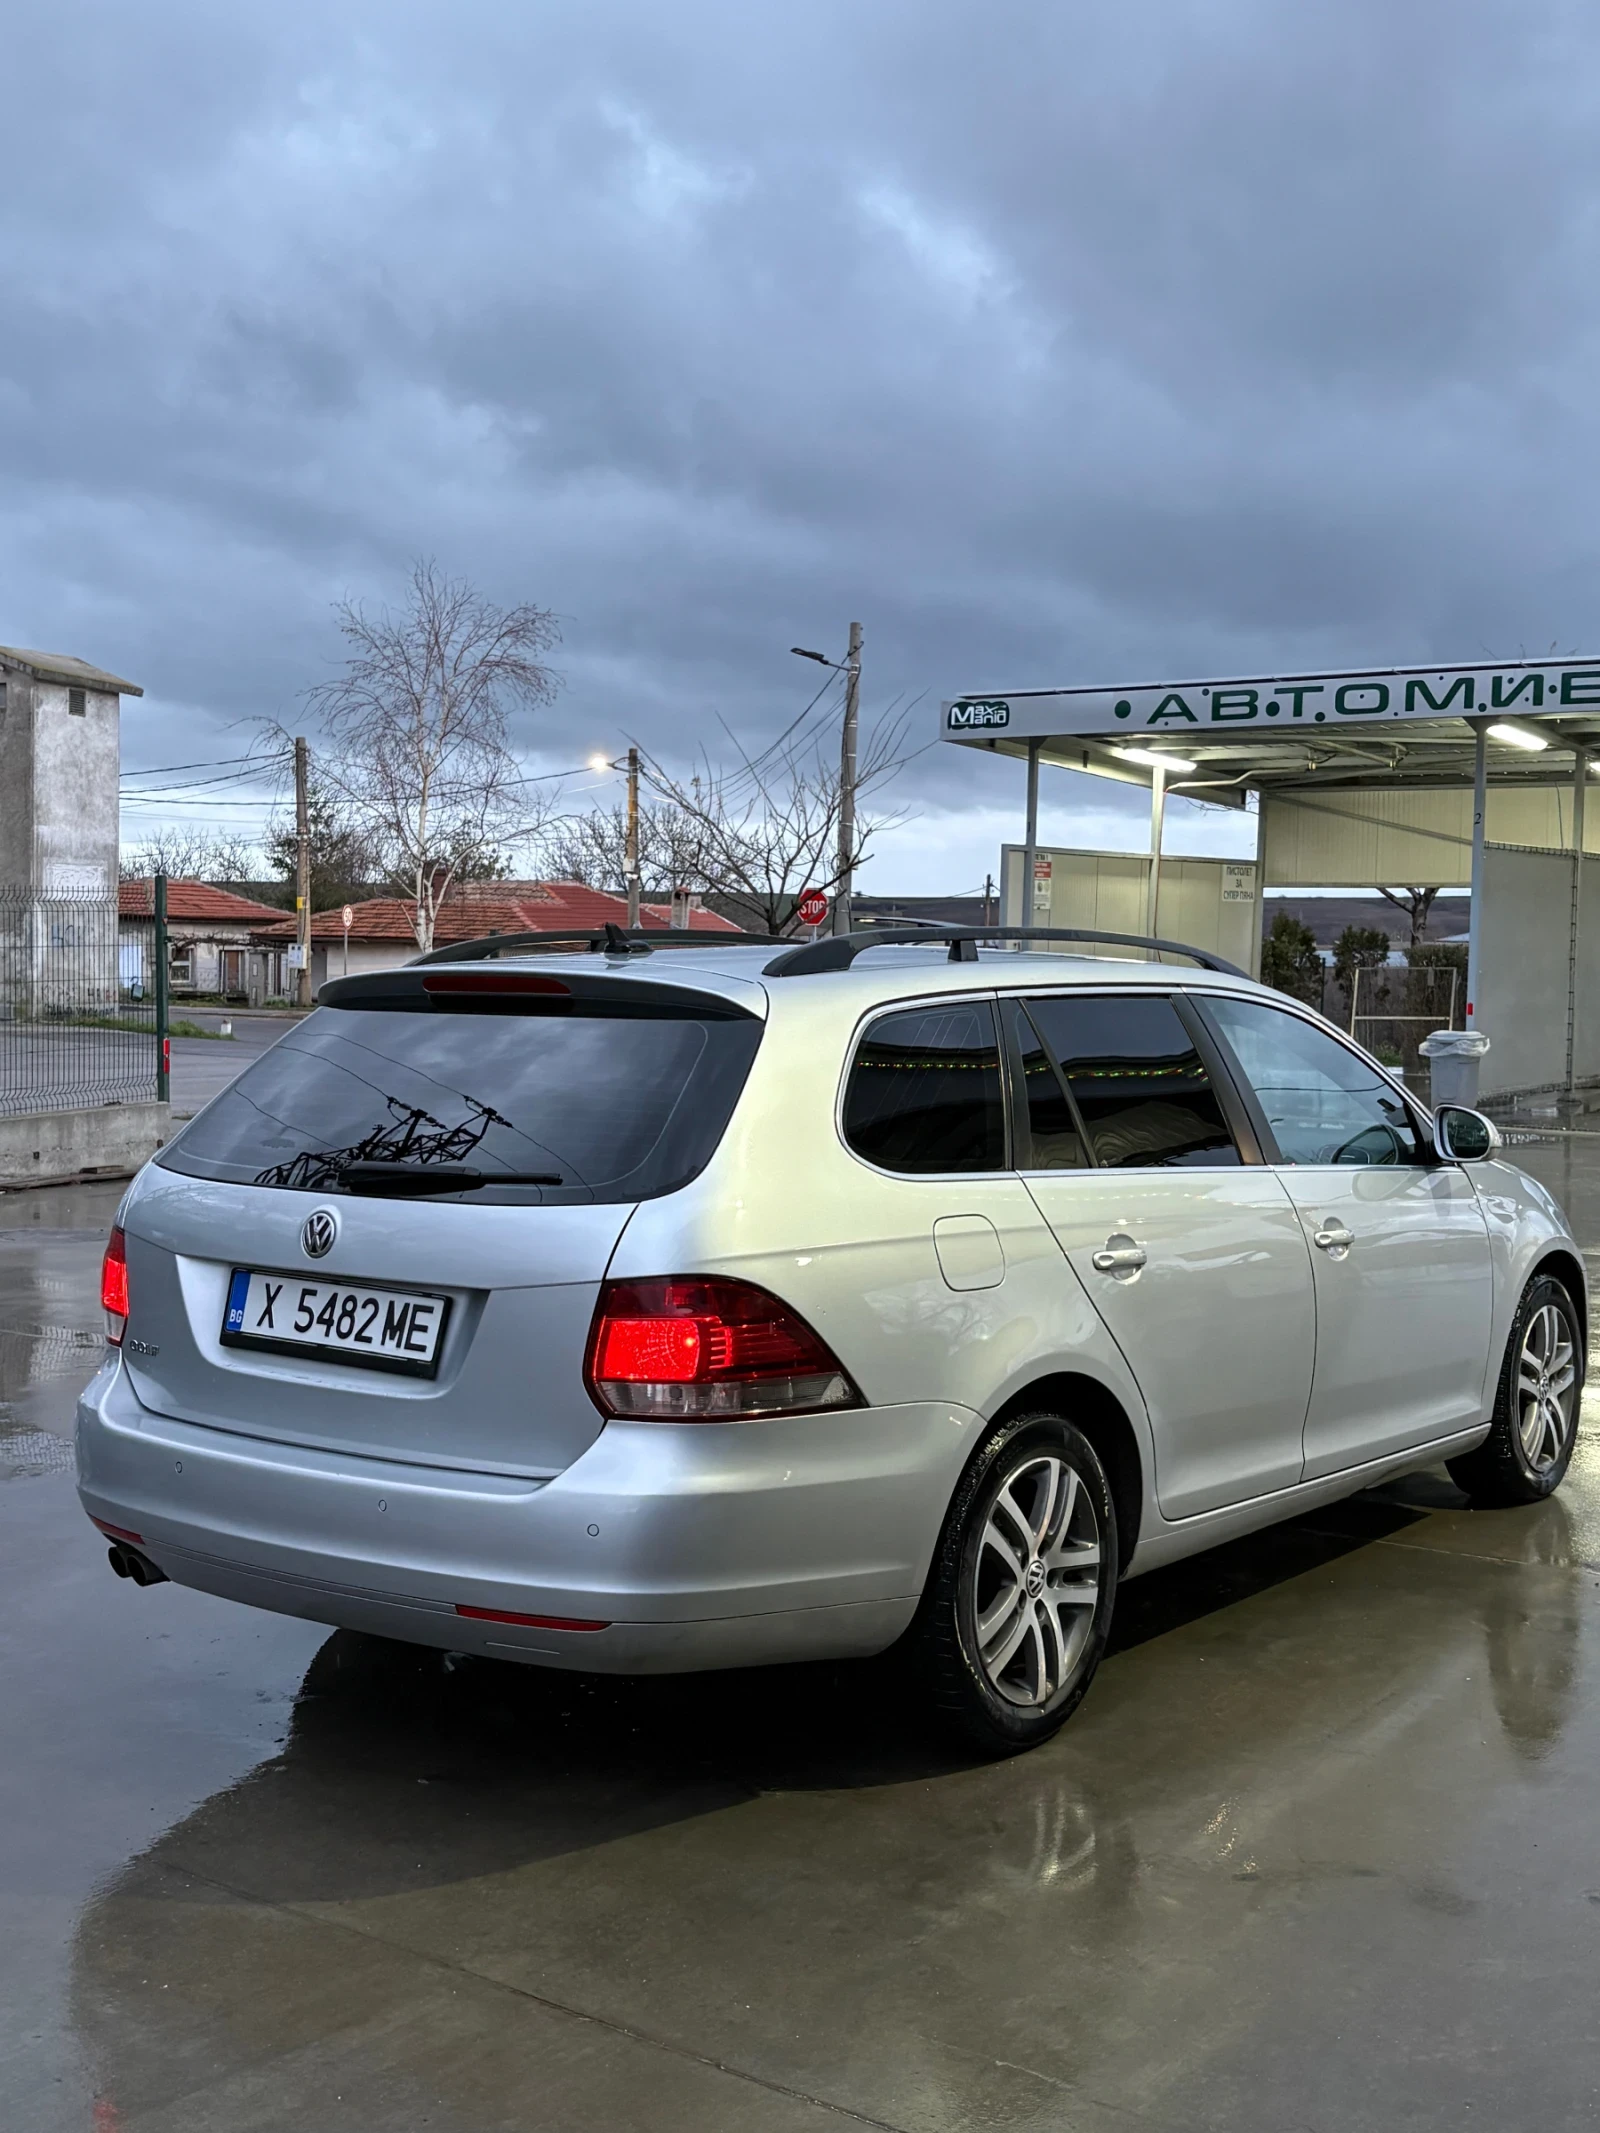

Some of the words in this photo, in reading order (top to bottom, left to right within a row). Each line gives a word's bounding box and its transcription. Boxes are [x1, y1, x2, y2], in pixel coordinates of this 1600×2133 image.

[1473, 812, 1482, 825] 2
[1226, 866, 1253, 876] ПИСТОЛЕТ
[1235, 878, 1243, 888] ЗА
[1223, 890, 1239, 900] СУПЕР
[256, 1282, 283, 1329] X
[229, 1308, 244, 1324] BG
